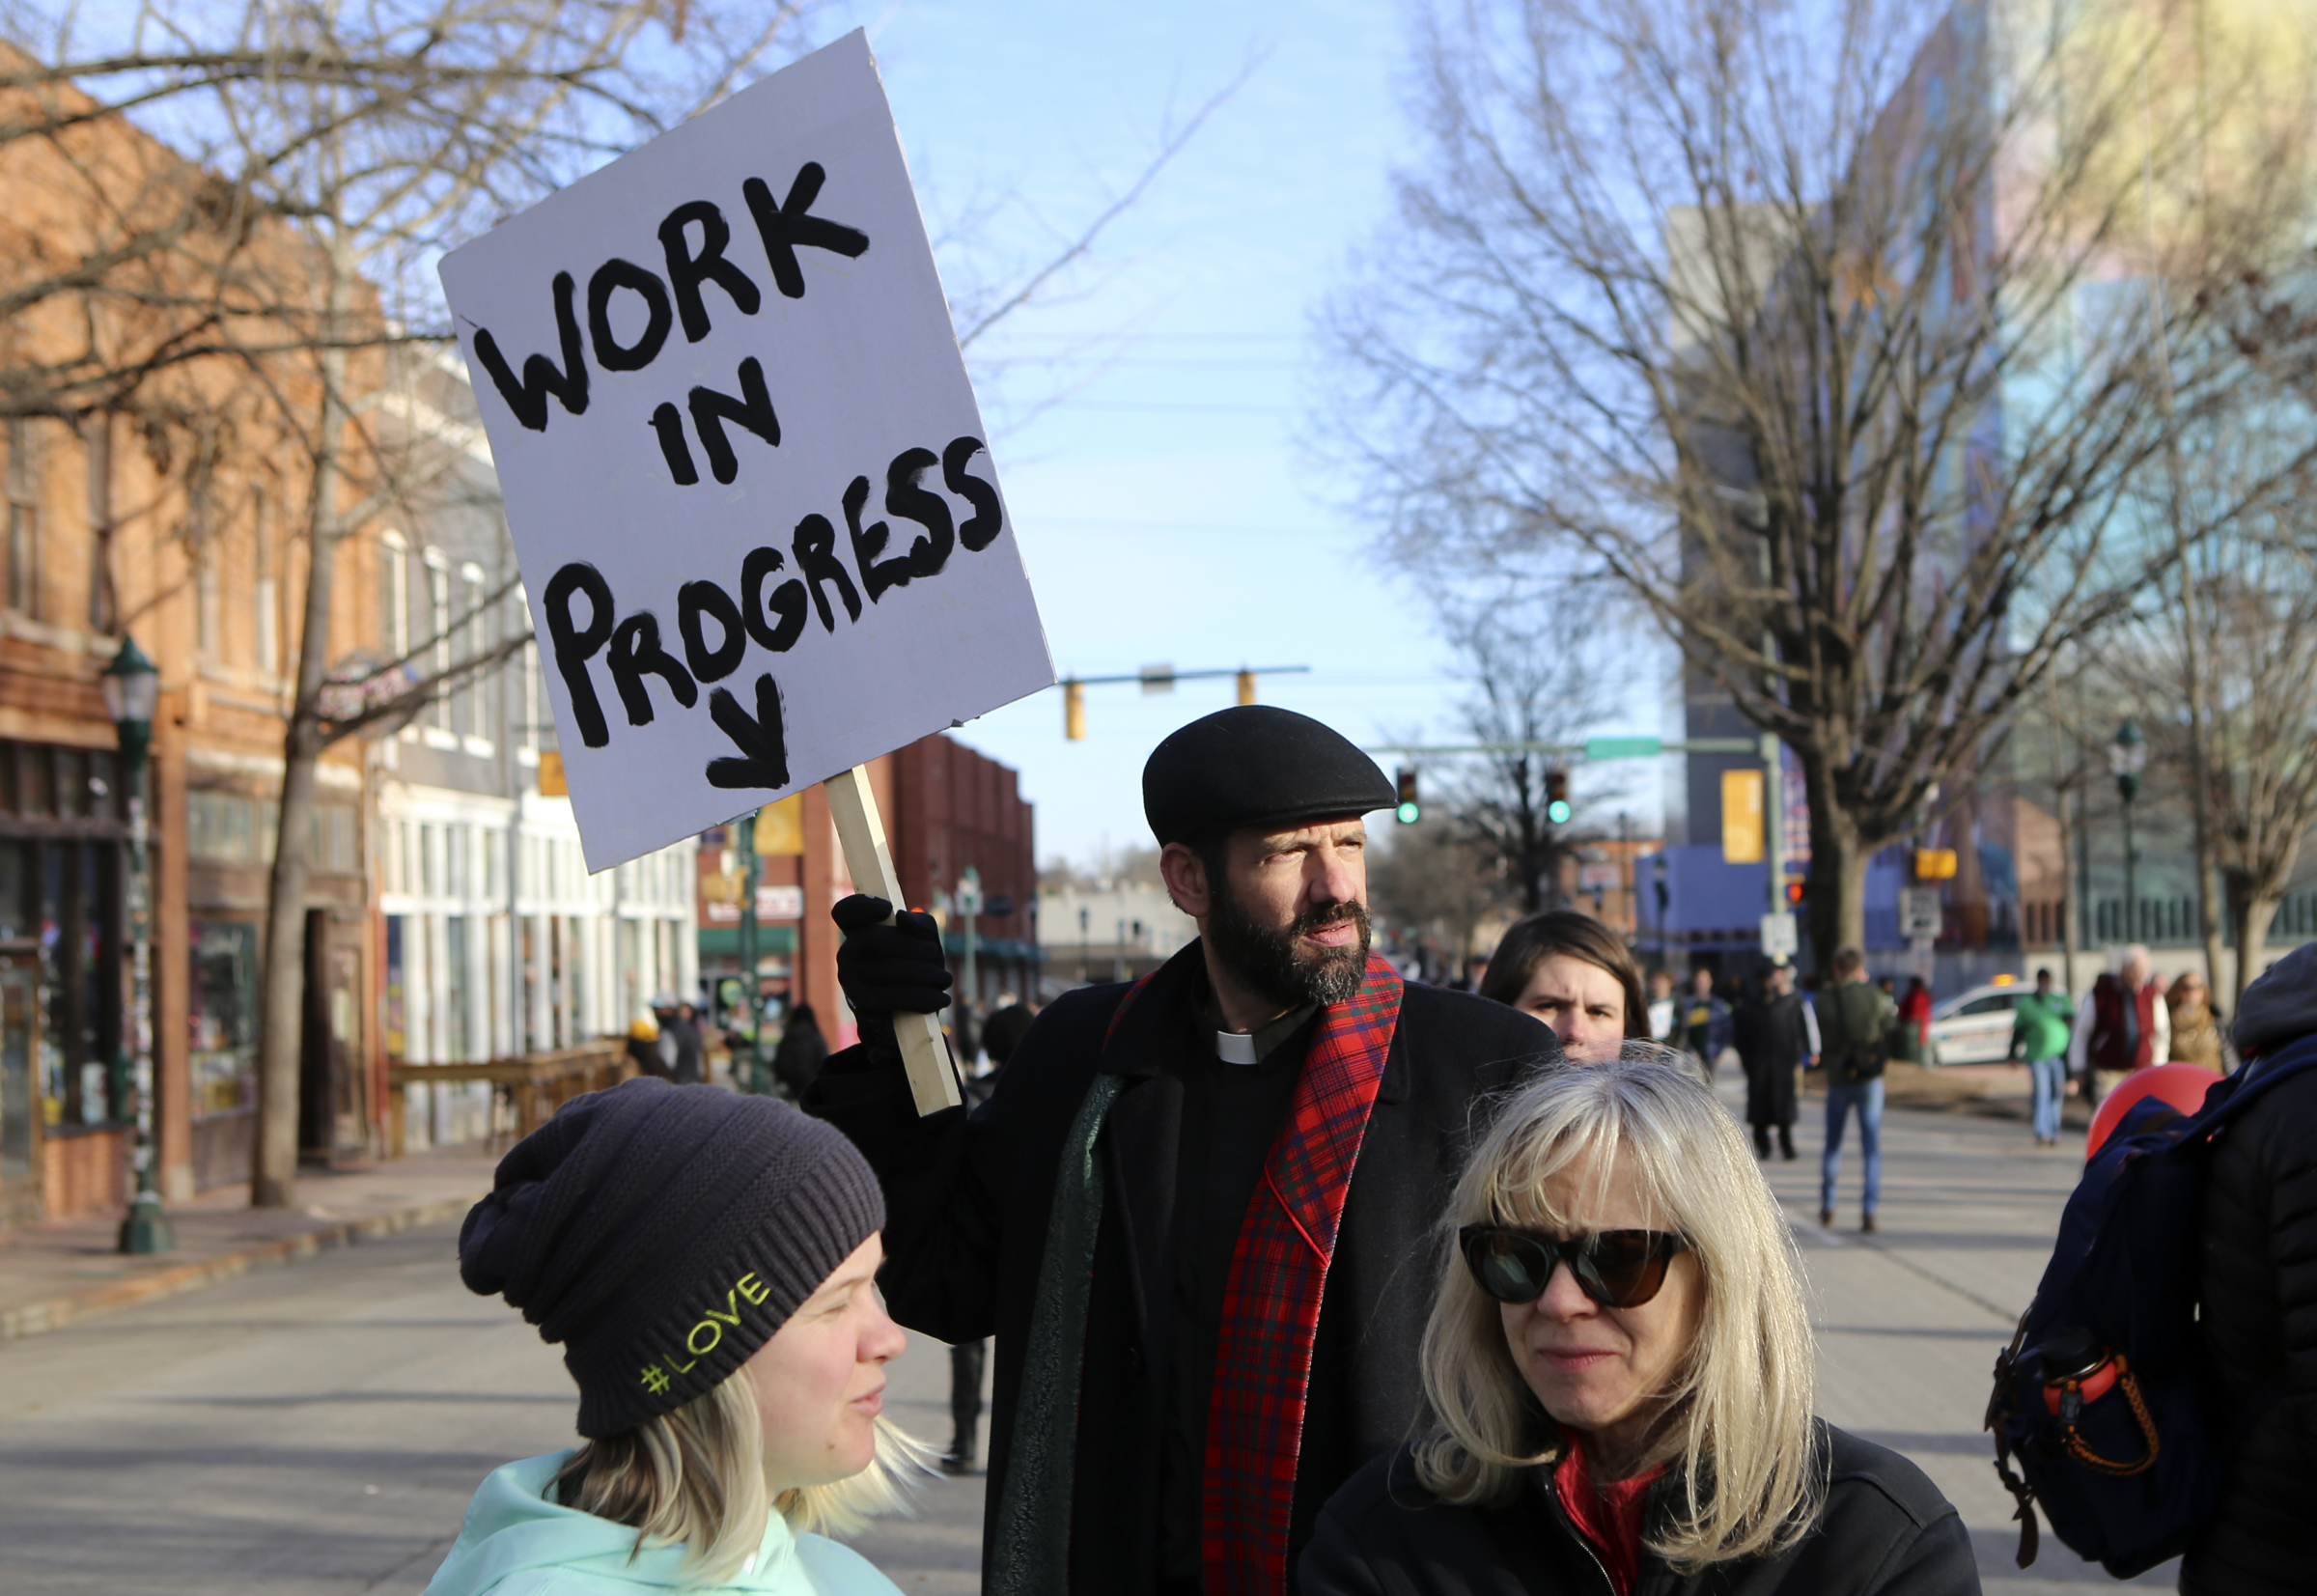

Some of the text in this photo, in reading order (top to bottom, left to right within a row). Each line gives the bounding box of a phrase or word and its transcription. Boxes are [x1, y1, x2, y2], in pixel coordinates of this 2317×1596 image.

[473, 162, 870, 433] WORK
[649, 357, 781, 486] IN
[544, 436, 1003, 748] PROGRESS
[641, 1272, 771, 1396] #LOVE
